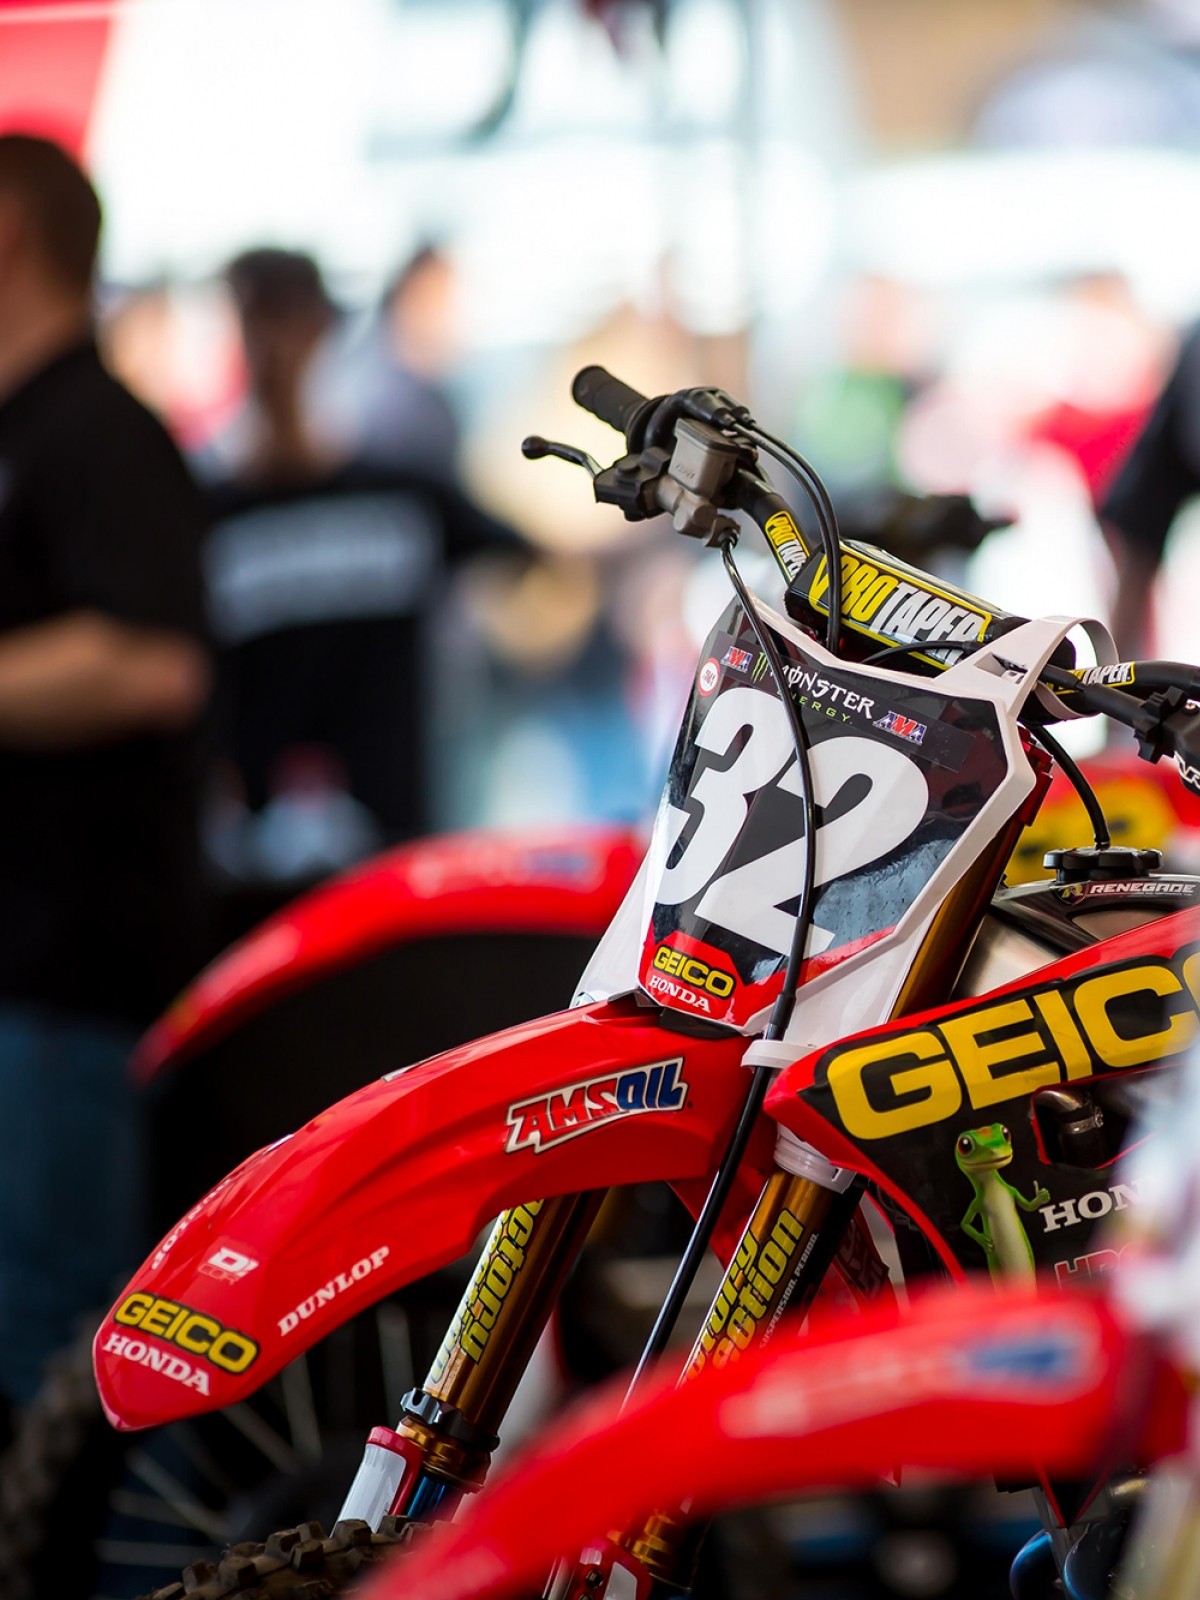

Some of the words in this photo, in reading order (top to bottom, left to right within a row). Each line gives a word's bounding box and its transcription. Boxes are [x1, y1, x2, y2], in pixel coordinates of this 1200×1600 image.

[777, 687, 852, 723] ERGY
[872, 709, 928, 746] AMA
[654, 687, 929, 959] 32
[1090, 882, 1196, 894] RENEGADE
[648, 975, 711, 1013] HONDA
[653, 946, 735, 998] GEICO
[508, 1060, 687, 1151] AMSOIL
[1039, 1182, 1144, 1233] HON
[277, 1245, 390, 1337] DUNLOP
[114, 1293, 258, 1374] GEICO
[102, 1333, 212, 1396] HONDA
